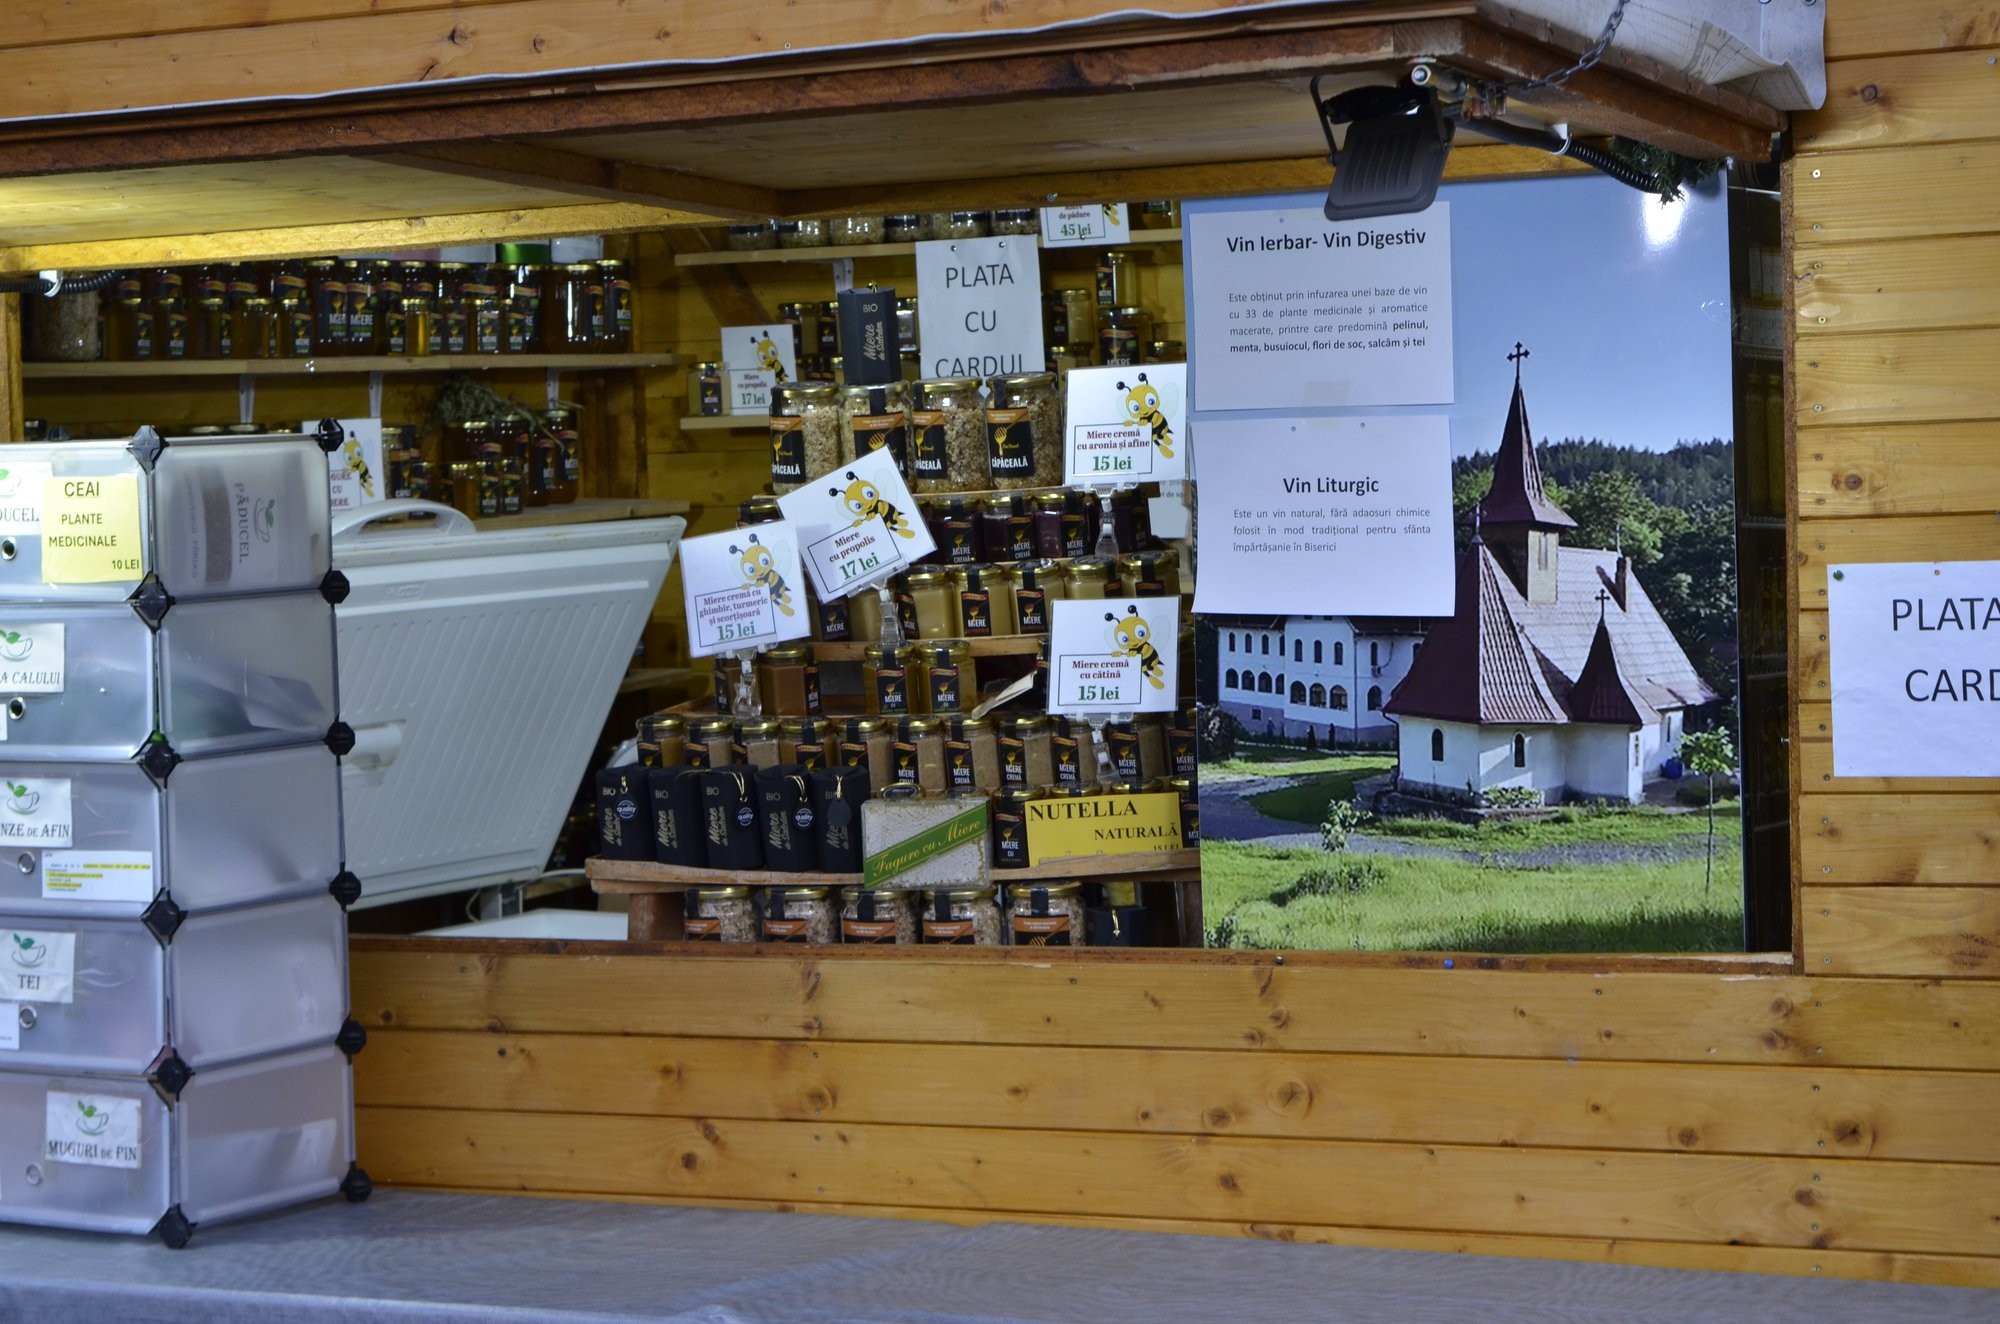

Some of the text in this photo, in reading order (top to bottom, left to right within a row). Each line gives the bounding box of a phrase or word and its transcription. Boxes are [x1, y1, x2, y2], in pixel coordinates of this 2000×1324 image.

[1060, 223, 1091, 236] 45 lei
[1226, 236, 1255, 252] Vin
[1323, 231, 1351, 248] Vin
[1357, 228, 1427, 249] Digestiv
[945, 263, 1015, 289] PLATA
[1229, 285, 1428, 303] Este obținut prin infuzarea unei baze de vin
[863, 303, 878, 312] BIO
[1229, 311, 1240, 319] cu
[1245, 309, 1257, 319] 33
[1262, 308, 1274, 318] de
[1279, 307, 1308, 319] plante
[1313, 305, 1363, 316] medicinale
[1381, 302, 1428, 314] aromatice
[964, 310, 997, 333] CU
[1229, 320, 1429, 337] macerate, printre care predomină pelinul,
[1230, 344, 1262, 354] menta,
[1263, 341, 1310, 352] busuiocul,
[1312, 340, 1331, 350] flori
[1333, 339, 1346, 349] de
[1347, 341, 1366, 350] soc,
[1412, 336, 1426, 347] tei
[741, 393, 752, 405] 17
[1086, 428, 1141, 439] Miere cremă
[1077, 442, 1088, 450] cu
[1088, 440, 1118, 450] aronia
[1128, 439, 1151, 448] afine
[1093, 456, 1132, 471] 15 lei
[64, 481, 100, 497] CEAI
[1282, 476, 1379, 496] Vin Liturgic
[0, 507, 40, 522] UCEL
[61, 513, 103, 525] PLANTE
[1233, 506, 1431, 519] Este un vin natural, fără adaosuri chimice
[1233, 524, 1431, 536] folosit în mod tradițional pentru sfânta
[49, 535, 117, 547] MEDICINALE
[834, 532, 860, 548] Miere
[1293, 542, 1302, 552] în
[1304, 542, 1336, 552] Biserici
[829, 535, 876, 563] cu propolis
[111, 559, 140, 570] 10 LEI
[839, 552, 880, 581] 17 lei
[703, 589, 762, 606] Miere cremă cu
[699, 596, 769, 619] ghimbir, turmeric
[716, 621, 756, 642] 15 lei
[1072, 659, 1129, 669] Miere cremă
[12, 671, 60, 685] CALULUI
[1080, 670, 1121, 679] cu cătină
[1078, 685, 1119, 701] 15 lei
[1005, 764, 1022, 774] MIERE
[1029, 800, 1138, 821] NUTELLA
[41, 824, 70, 838] AFIN
[1094, 822, 1179, 841] NATURALĂ
[1001, 841, 1019, 850] MIERE
[17, 974, 40, 990] TEI
[48, 1140, 98, 1159] MUGURI
